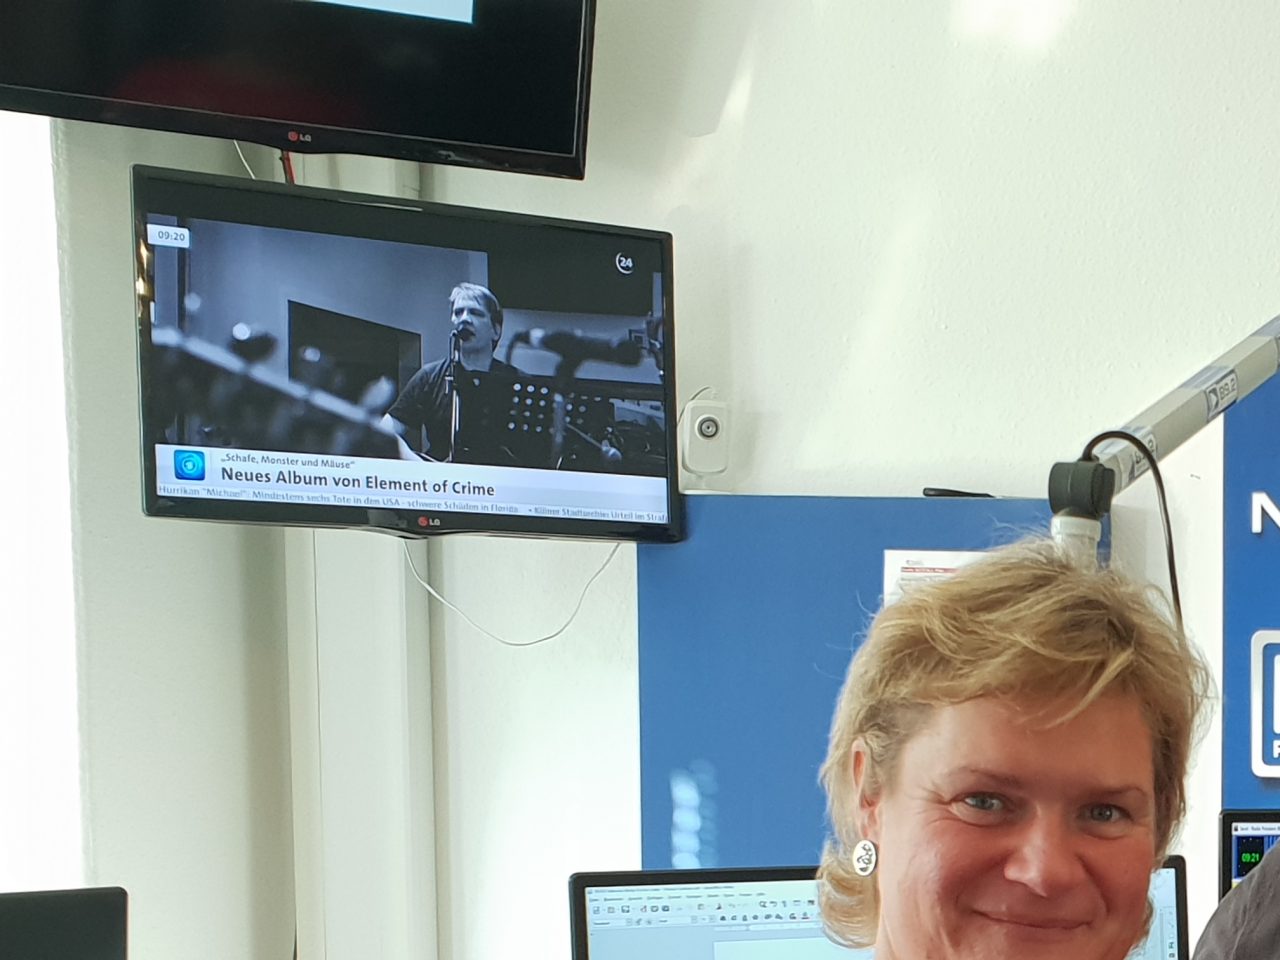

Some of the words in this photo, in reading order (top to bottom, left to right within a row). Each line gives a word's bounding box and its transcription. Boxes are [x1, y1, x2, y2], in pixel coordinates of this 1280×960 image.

[157, 230, 186, 241] 09:20
[619, 256, 633, 268] 24
[261, 455, 299, 466] Monster
[302, 457, 319, 467] und
[221, 467, 271, 483] Neues
[276, 470, 328, 486] Album
[332, 475, 361, 488] von
[366, 474, 428, 492] Element
[432, 480, 449, 493] of
[452, 481, 495, 496] Crime
[354, 496, 362, 504] in
[481, 503, 489, 511] in
